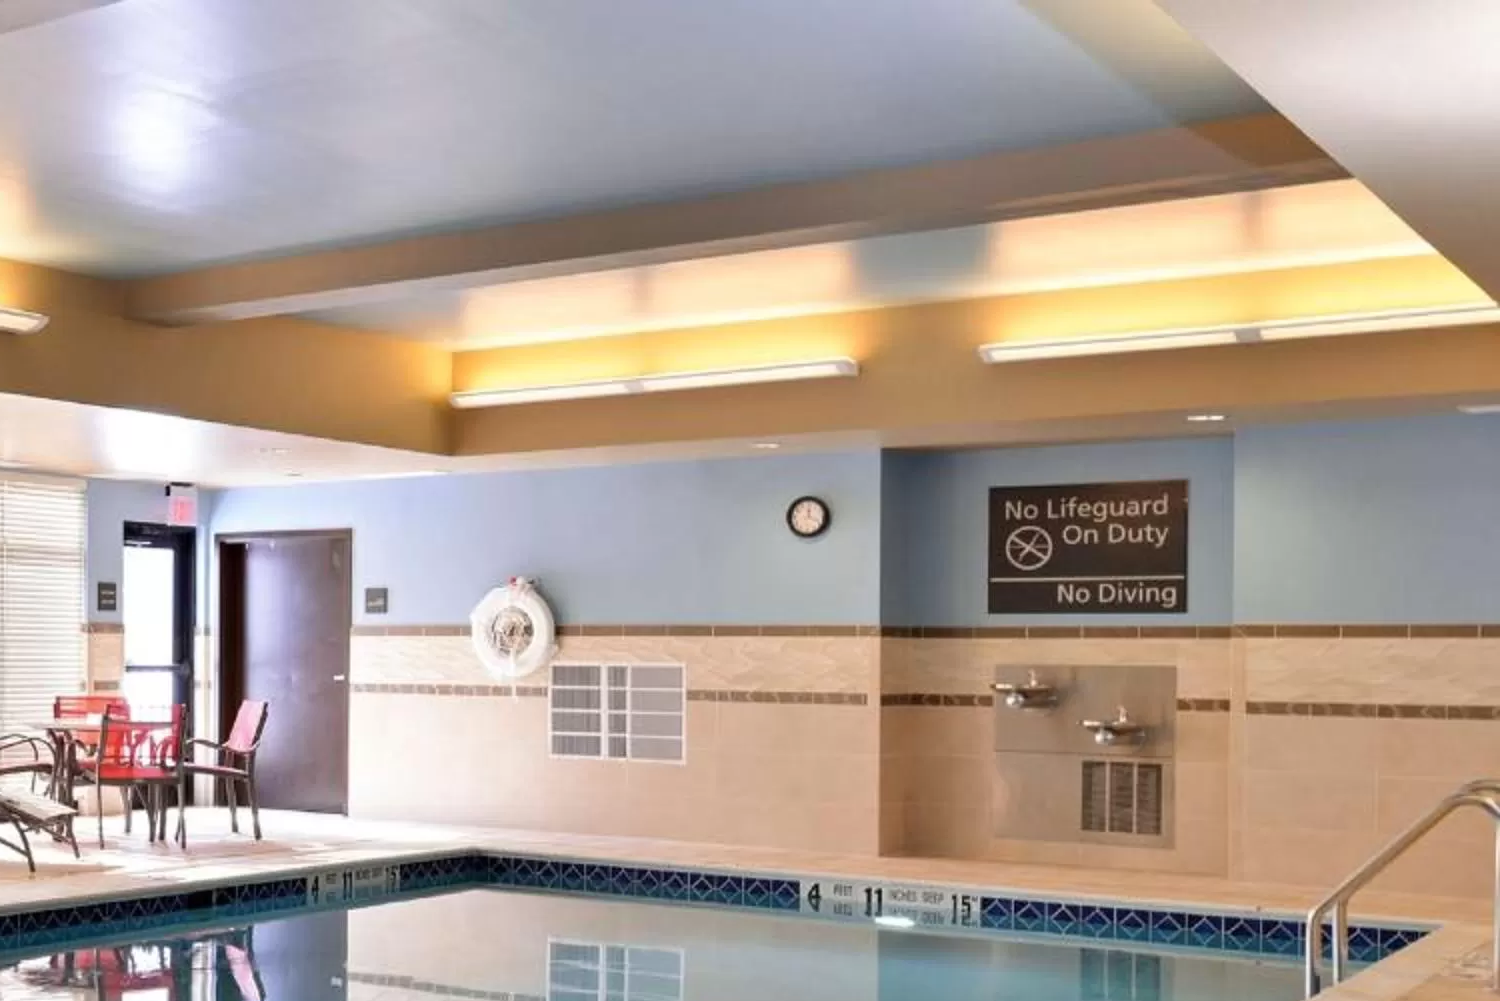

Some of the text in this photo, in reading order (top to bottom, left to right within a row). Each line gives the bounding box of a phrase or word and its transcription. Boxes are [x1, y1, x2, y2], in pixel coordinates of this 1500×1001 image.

[1005, 493, 1170, 523] No Lifeguard
[1061, 523, 1170, 549] On Duty
[1056, 582, 1178, 609] No Diving
[807, 883, 822, 900] 4
[864, 886, 883, 906] 11
